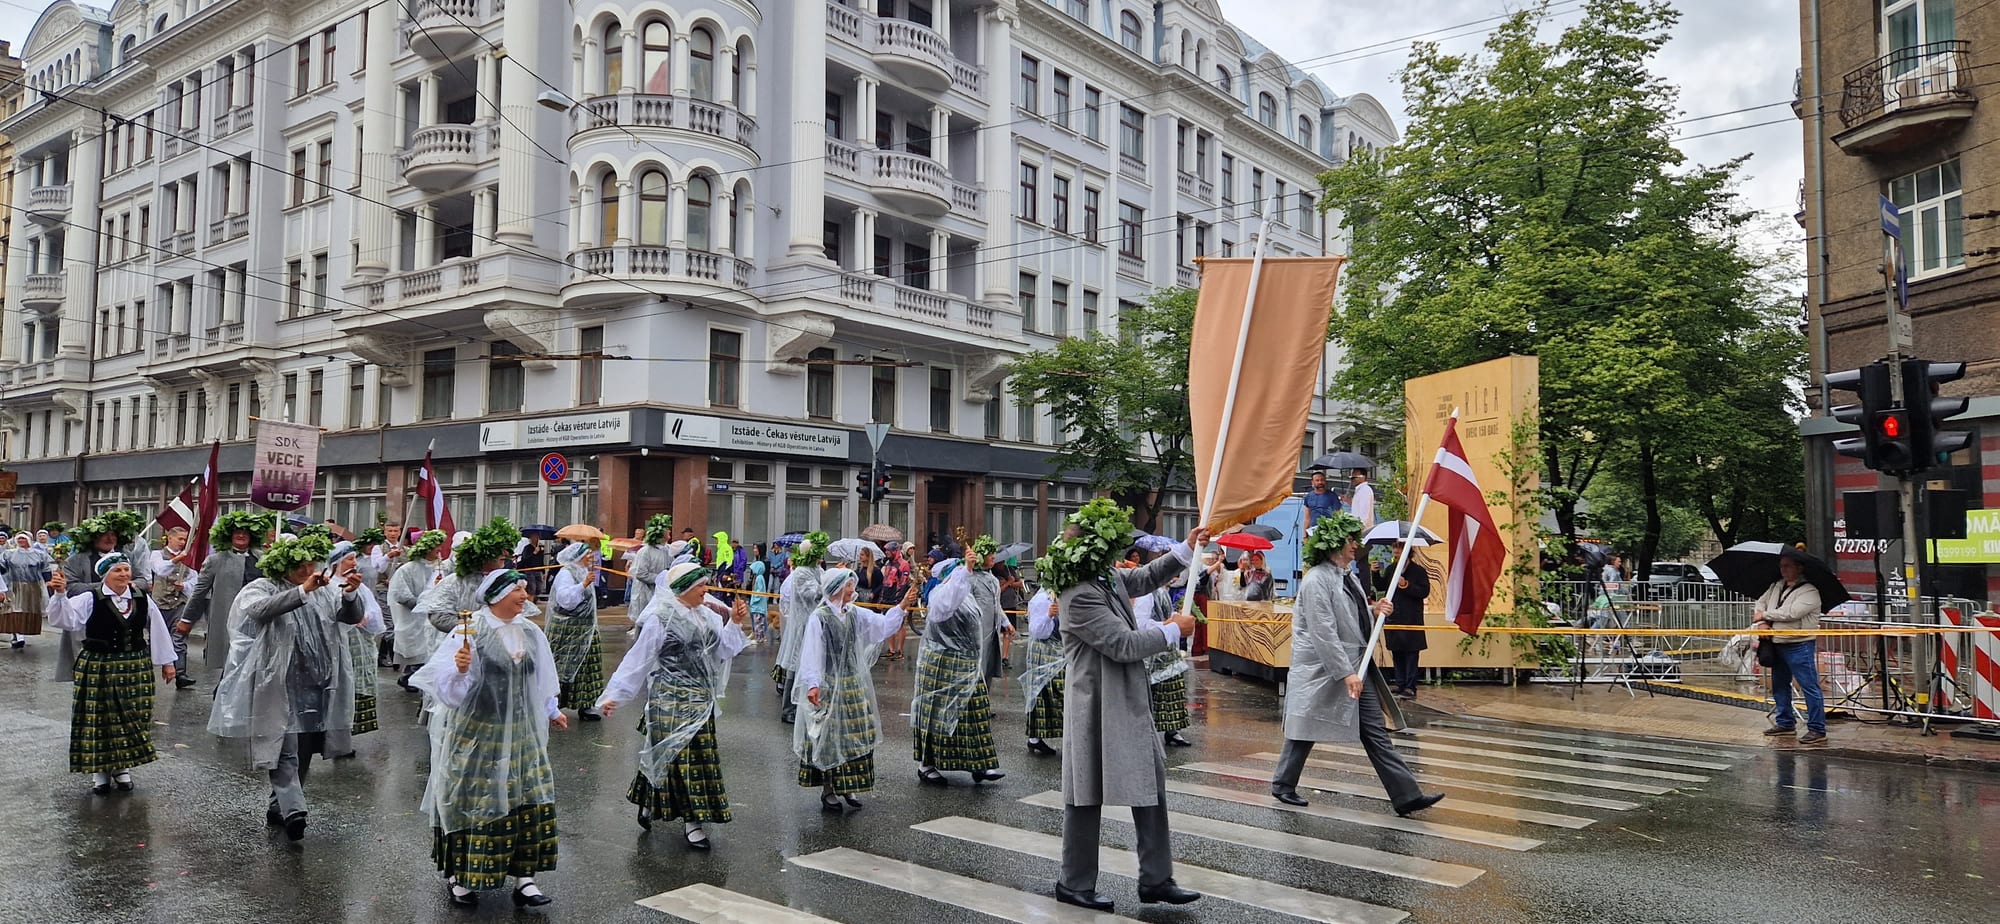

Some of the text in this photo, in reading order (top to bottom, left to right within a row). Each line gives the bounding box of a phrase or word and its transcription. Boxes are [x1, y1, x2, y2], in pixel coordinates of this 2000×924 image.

[528, 424, 549, 434] Izstāde
[554, 420, 571, 432] Čekas
[573, 421, 596, 431] vēsture
[598, 417, 621, 430] Latvijā
[275, 436, 300, 449] SDK
[732, 425, 760, 437] Izstāde
[766, 427, 788, 439] Čekas
[790, 432, 816, 442] vēsture
[818, 434, 841, 446] Latvijā
[267, 451, 304, 468] VECIE
